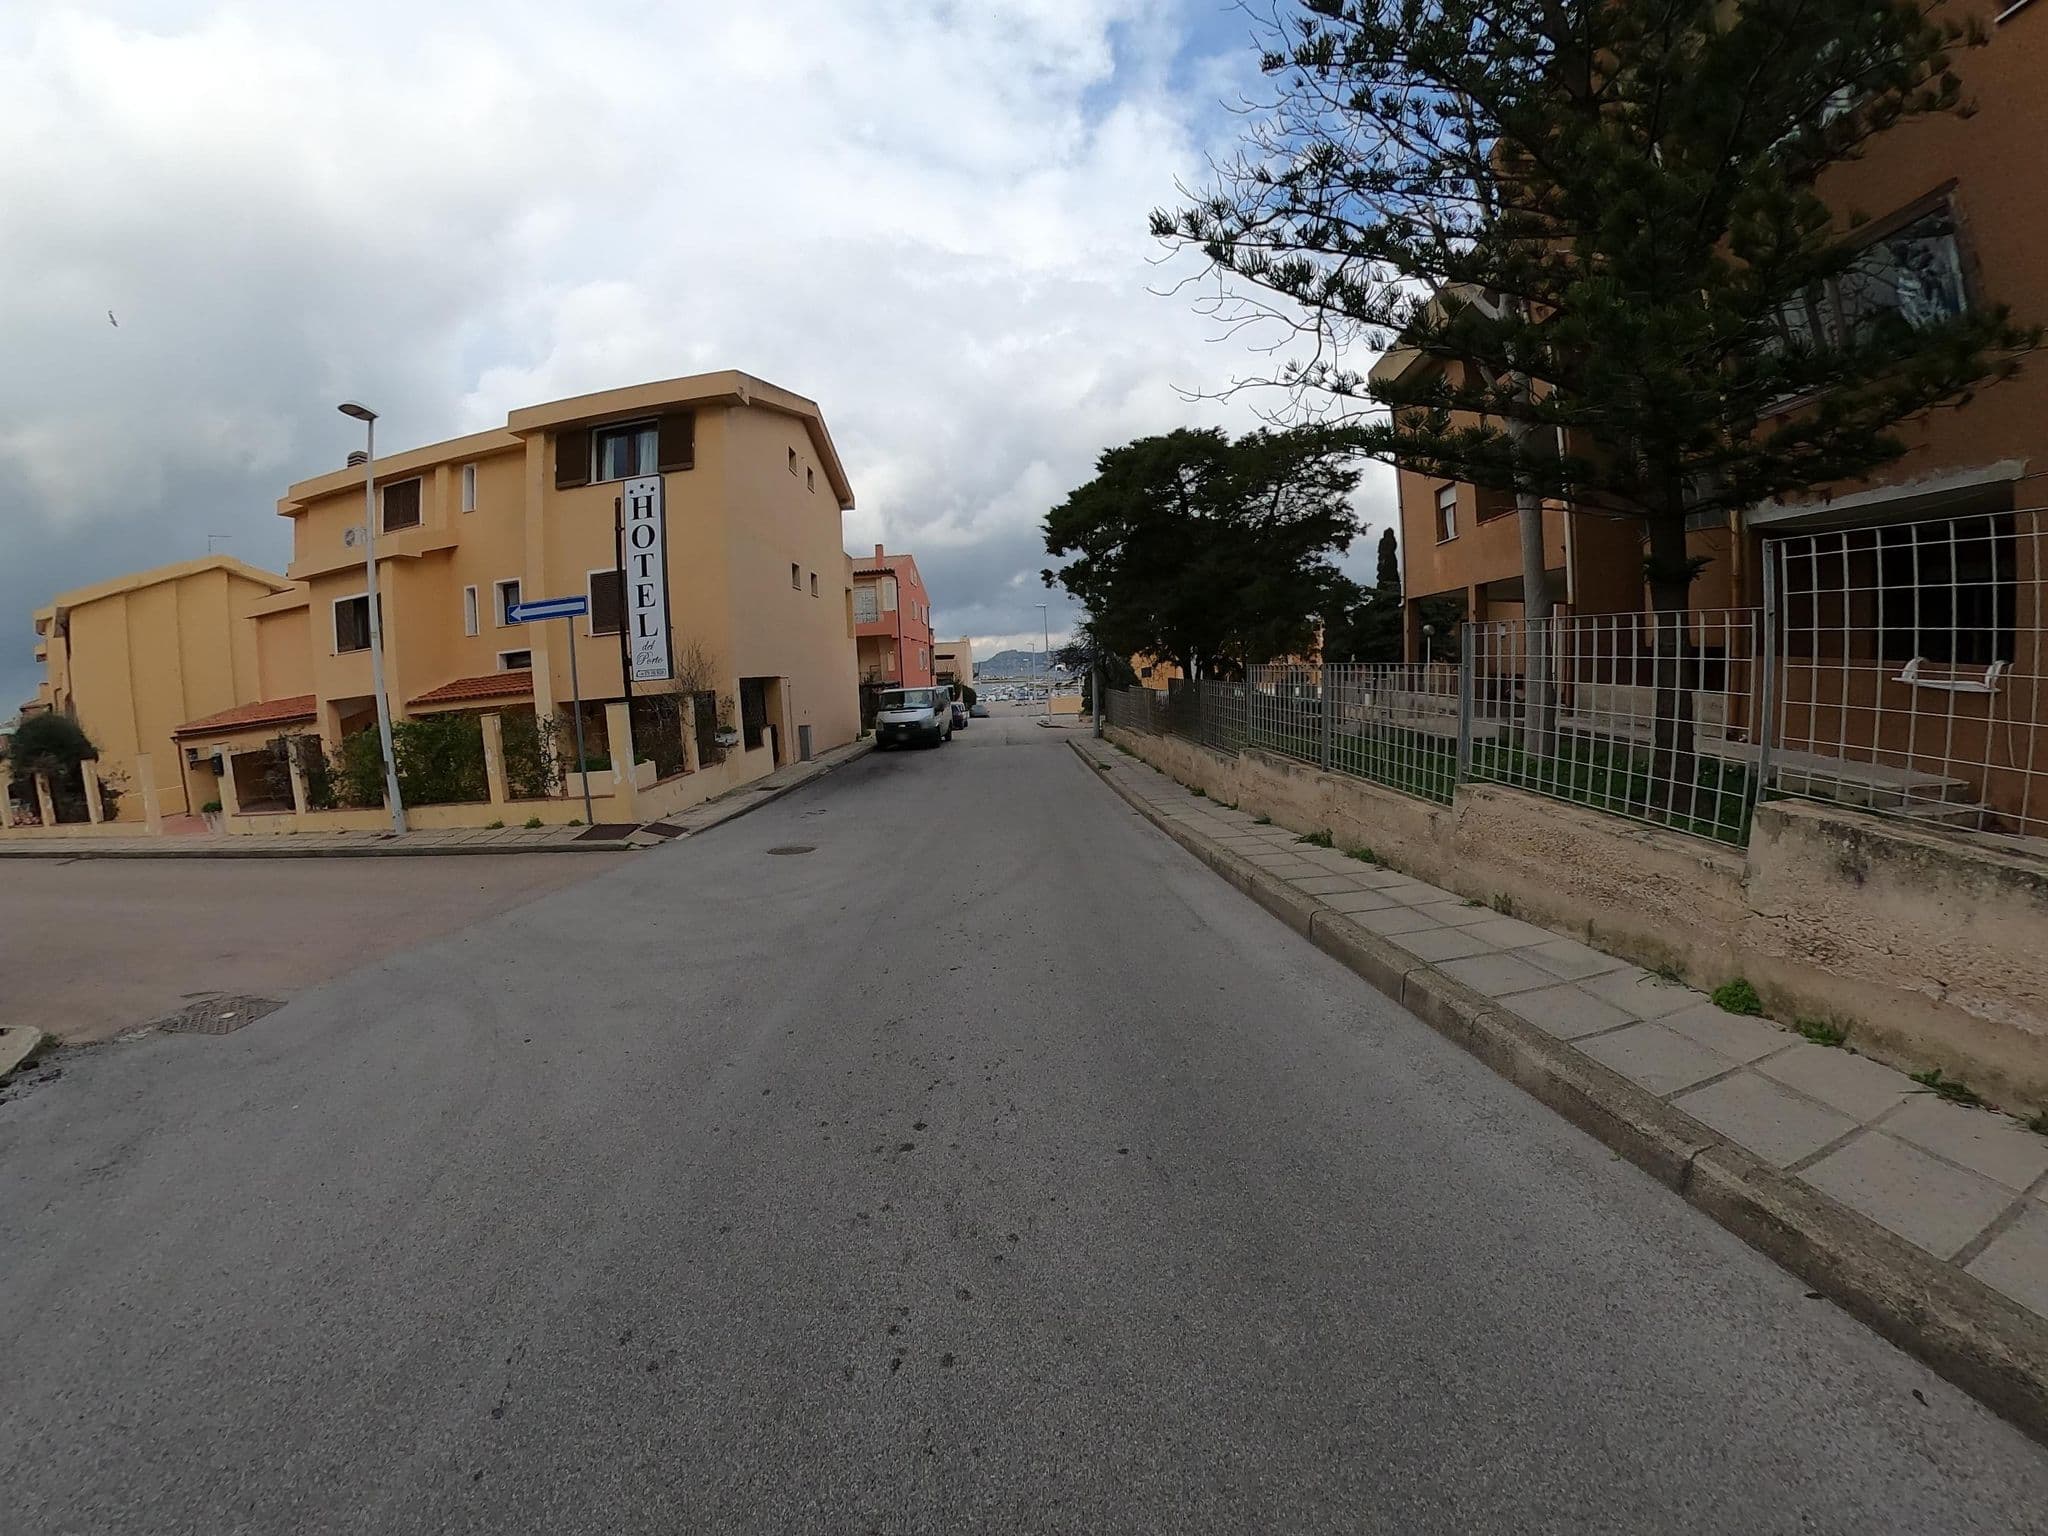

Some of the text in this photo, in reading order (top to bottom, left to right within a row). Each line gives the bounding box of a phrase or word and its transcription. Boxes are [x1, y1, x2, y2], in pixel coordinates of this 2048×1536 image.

[630, 495, 659, 638] HOTEL
[641, 640, 656, 651] del
[636, 651, 664, 666] Porto
